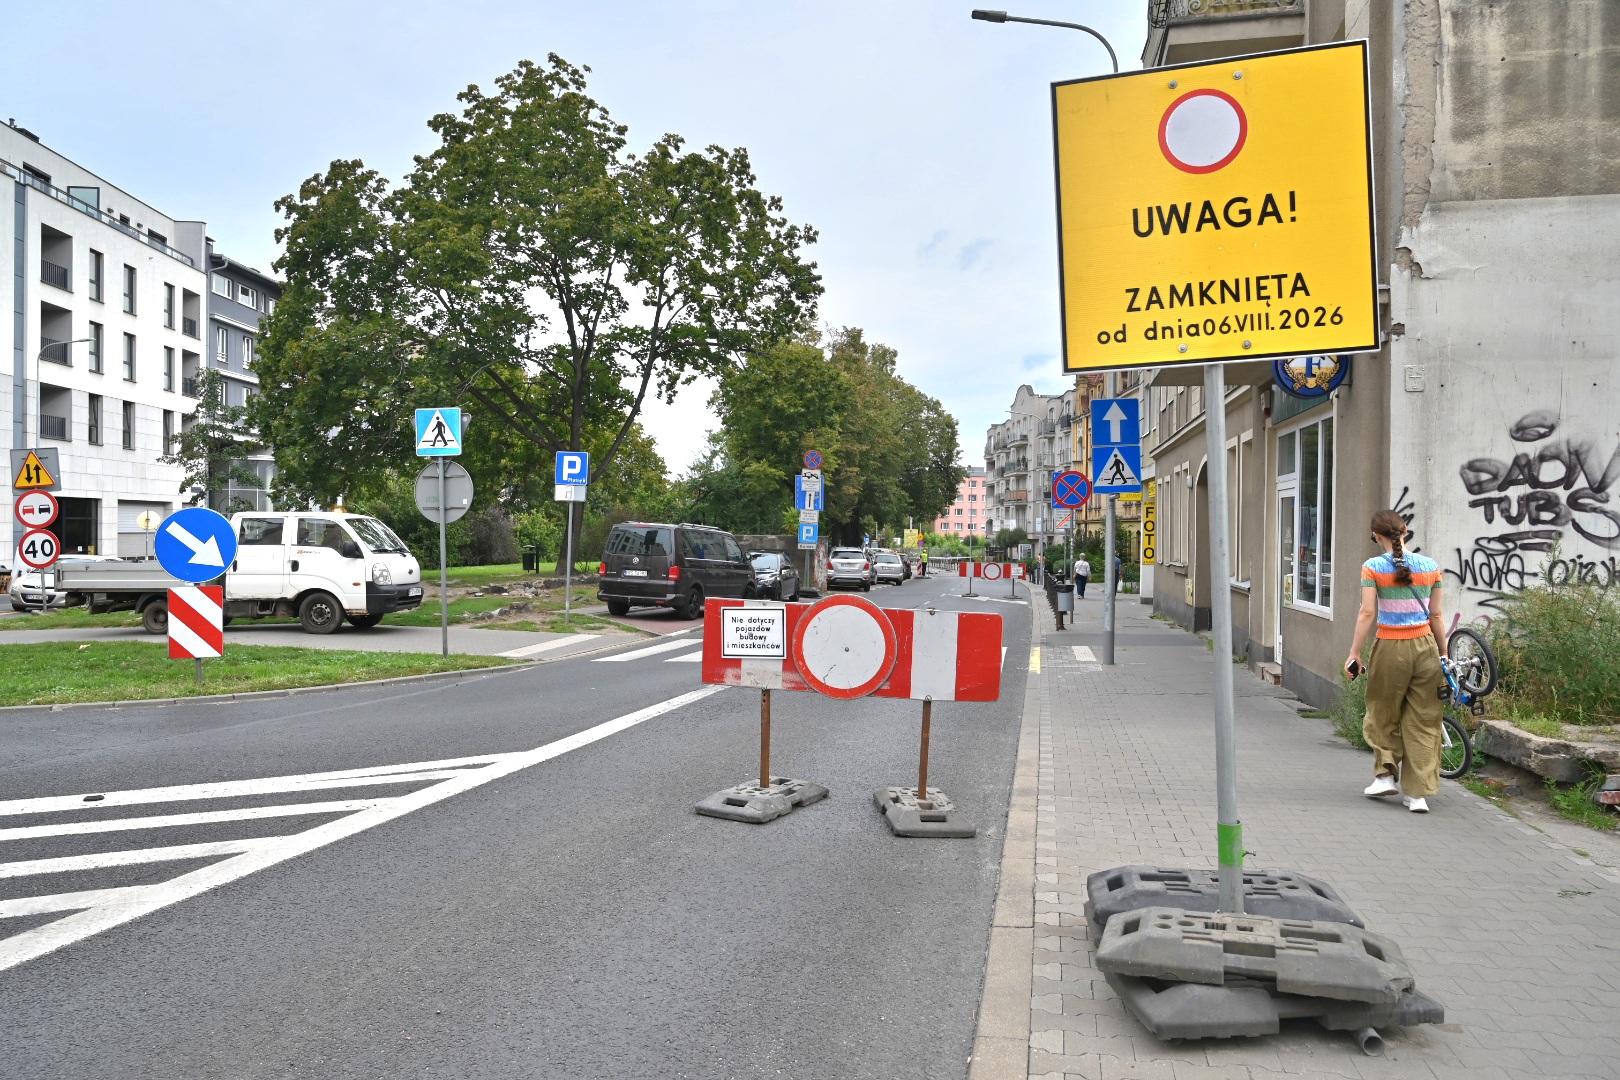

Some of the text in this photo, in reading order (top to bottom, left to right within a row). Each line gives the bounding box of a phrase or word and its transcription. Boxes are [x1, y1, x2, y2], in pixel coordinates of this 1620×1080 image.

[1131, 190, 1297, 239] UWAGA!
[1124, 271, 1311, 314] ZAMKNIĘTA
[1096, 323, 1127, 345] od
[1143, 506, 1155, 560] FOTO
[24, 538, 54, 559] 40
[731, 616, 775, 626] Nie dotyczy
[735, 624, 771, 634] pojazdów
[731, 641, 781, 650] mieszkańców
[739, 633, 767, 643] budowy
